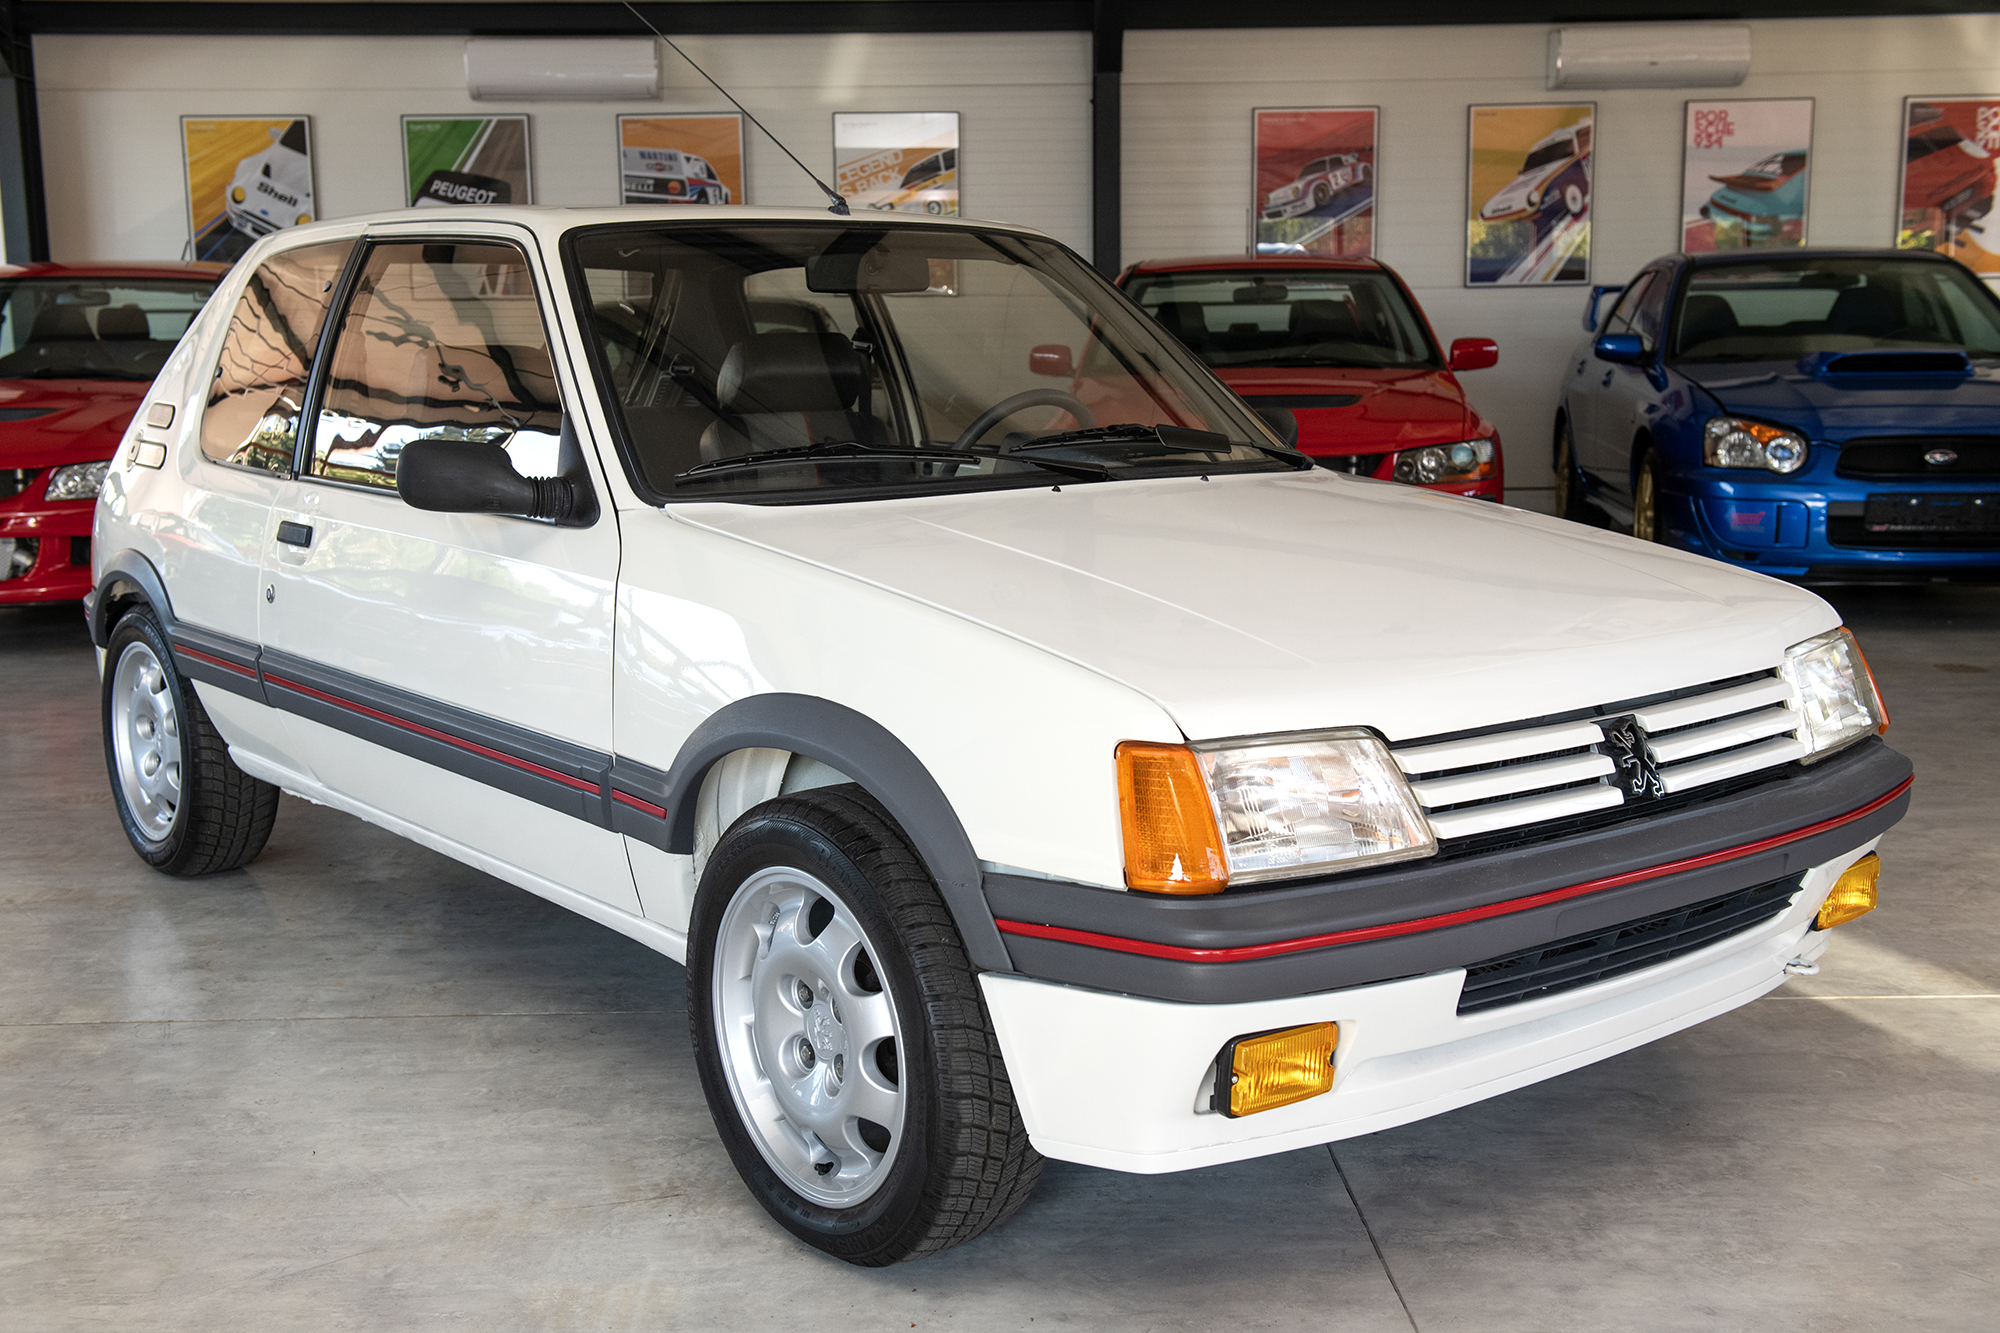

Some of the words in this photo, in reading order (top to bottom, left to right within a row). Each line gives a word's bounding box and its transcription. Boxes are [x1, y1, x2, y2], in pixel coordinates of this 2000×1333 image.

[838, 150, 903, 183] LEGEND
[856, 166, 901, 194] BACK
[257, 181, 299, 208] Shell
[429, 179, 498, 205] PEUGEOT
[838, 1214, 898, 1254] POLARIS
